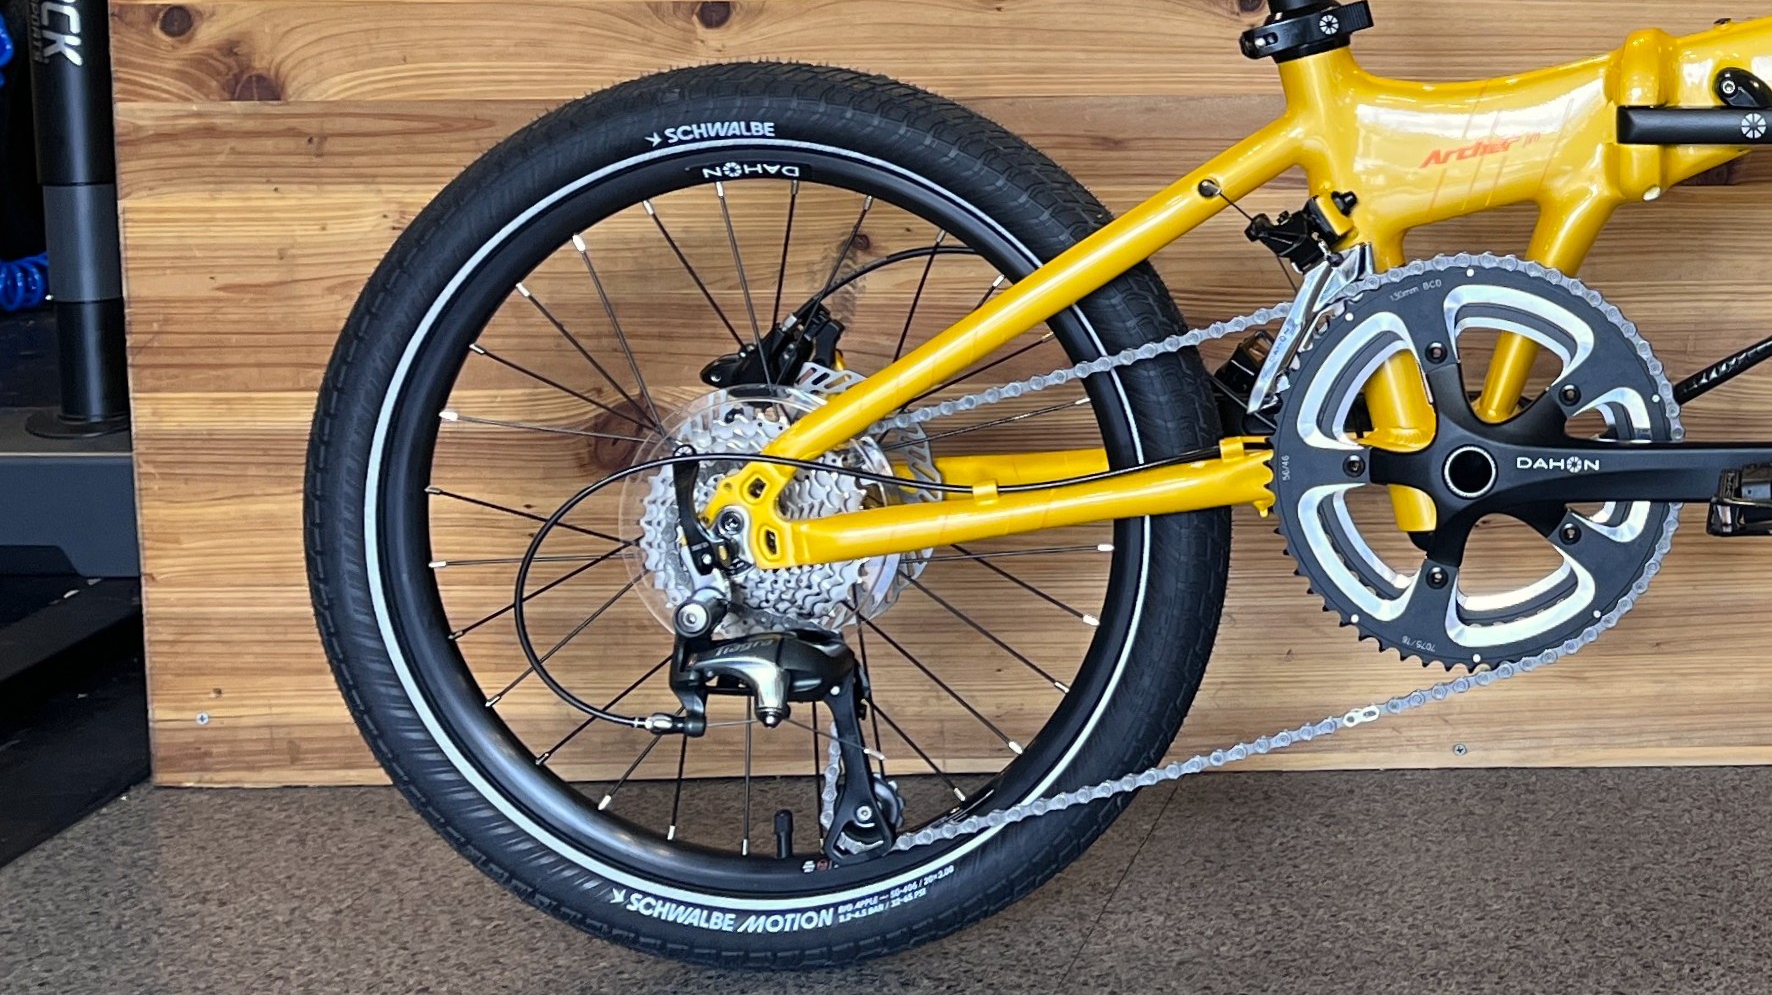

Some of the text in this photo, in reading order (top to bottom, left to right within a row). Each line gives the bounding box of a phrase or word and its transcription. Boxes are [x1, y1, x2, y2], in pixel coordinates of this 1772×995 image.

[664, 121, 776, 144] SCHWALBE
[702, 162, 800, 178] DAHON
[1516, 456, 1600, 473] DAHON
[626, 892, 833, 933] SCHWALBE MOTION
